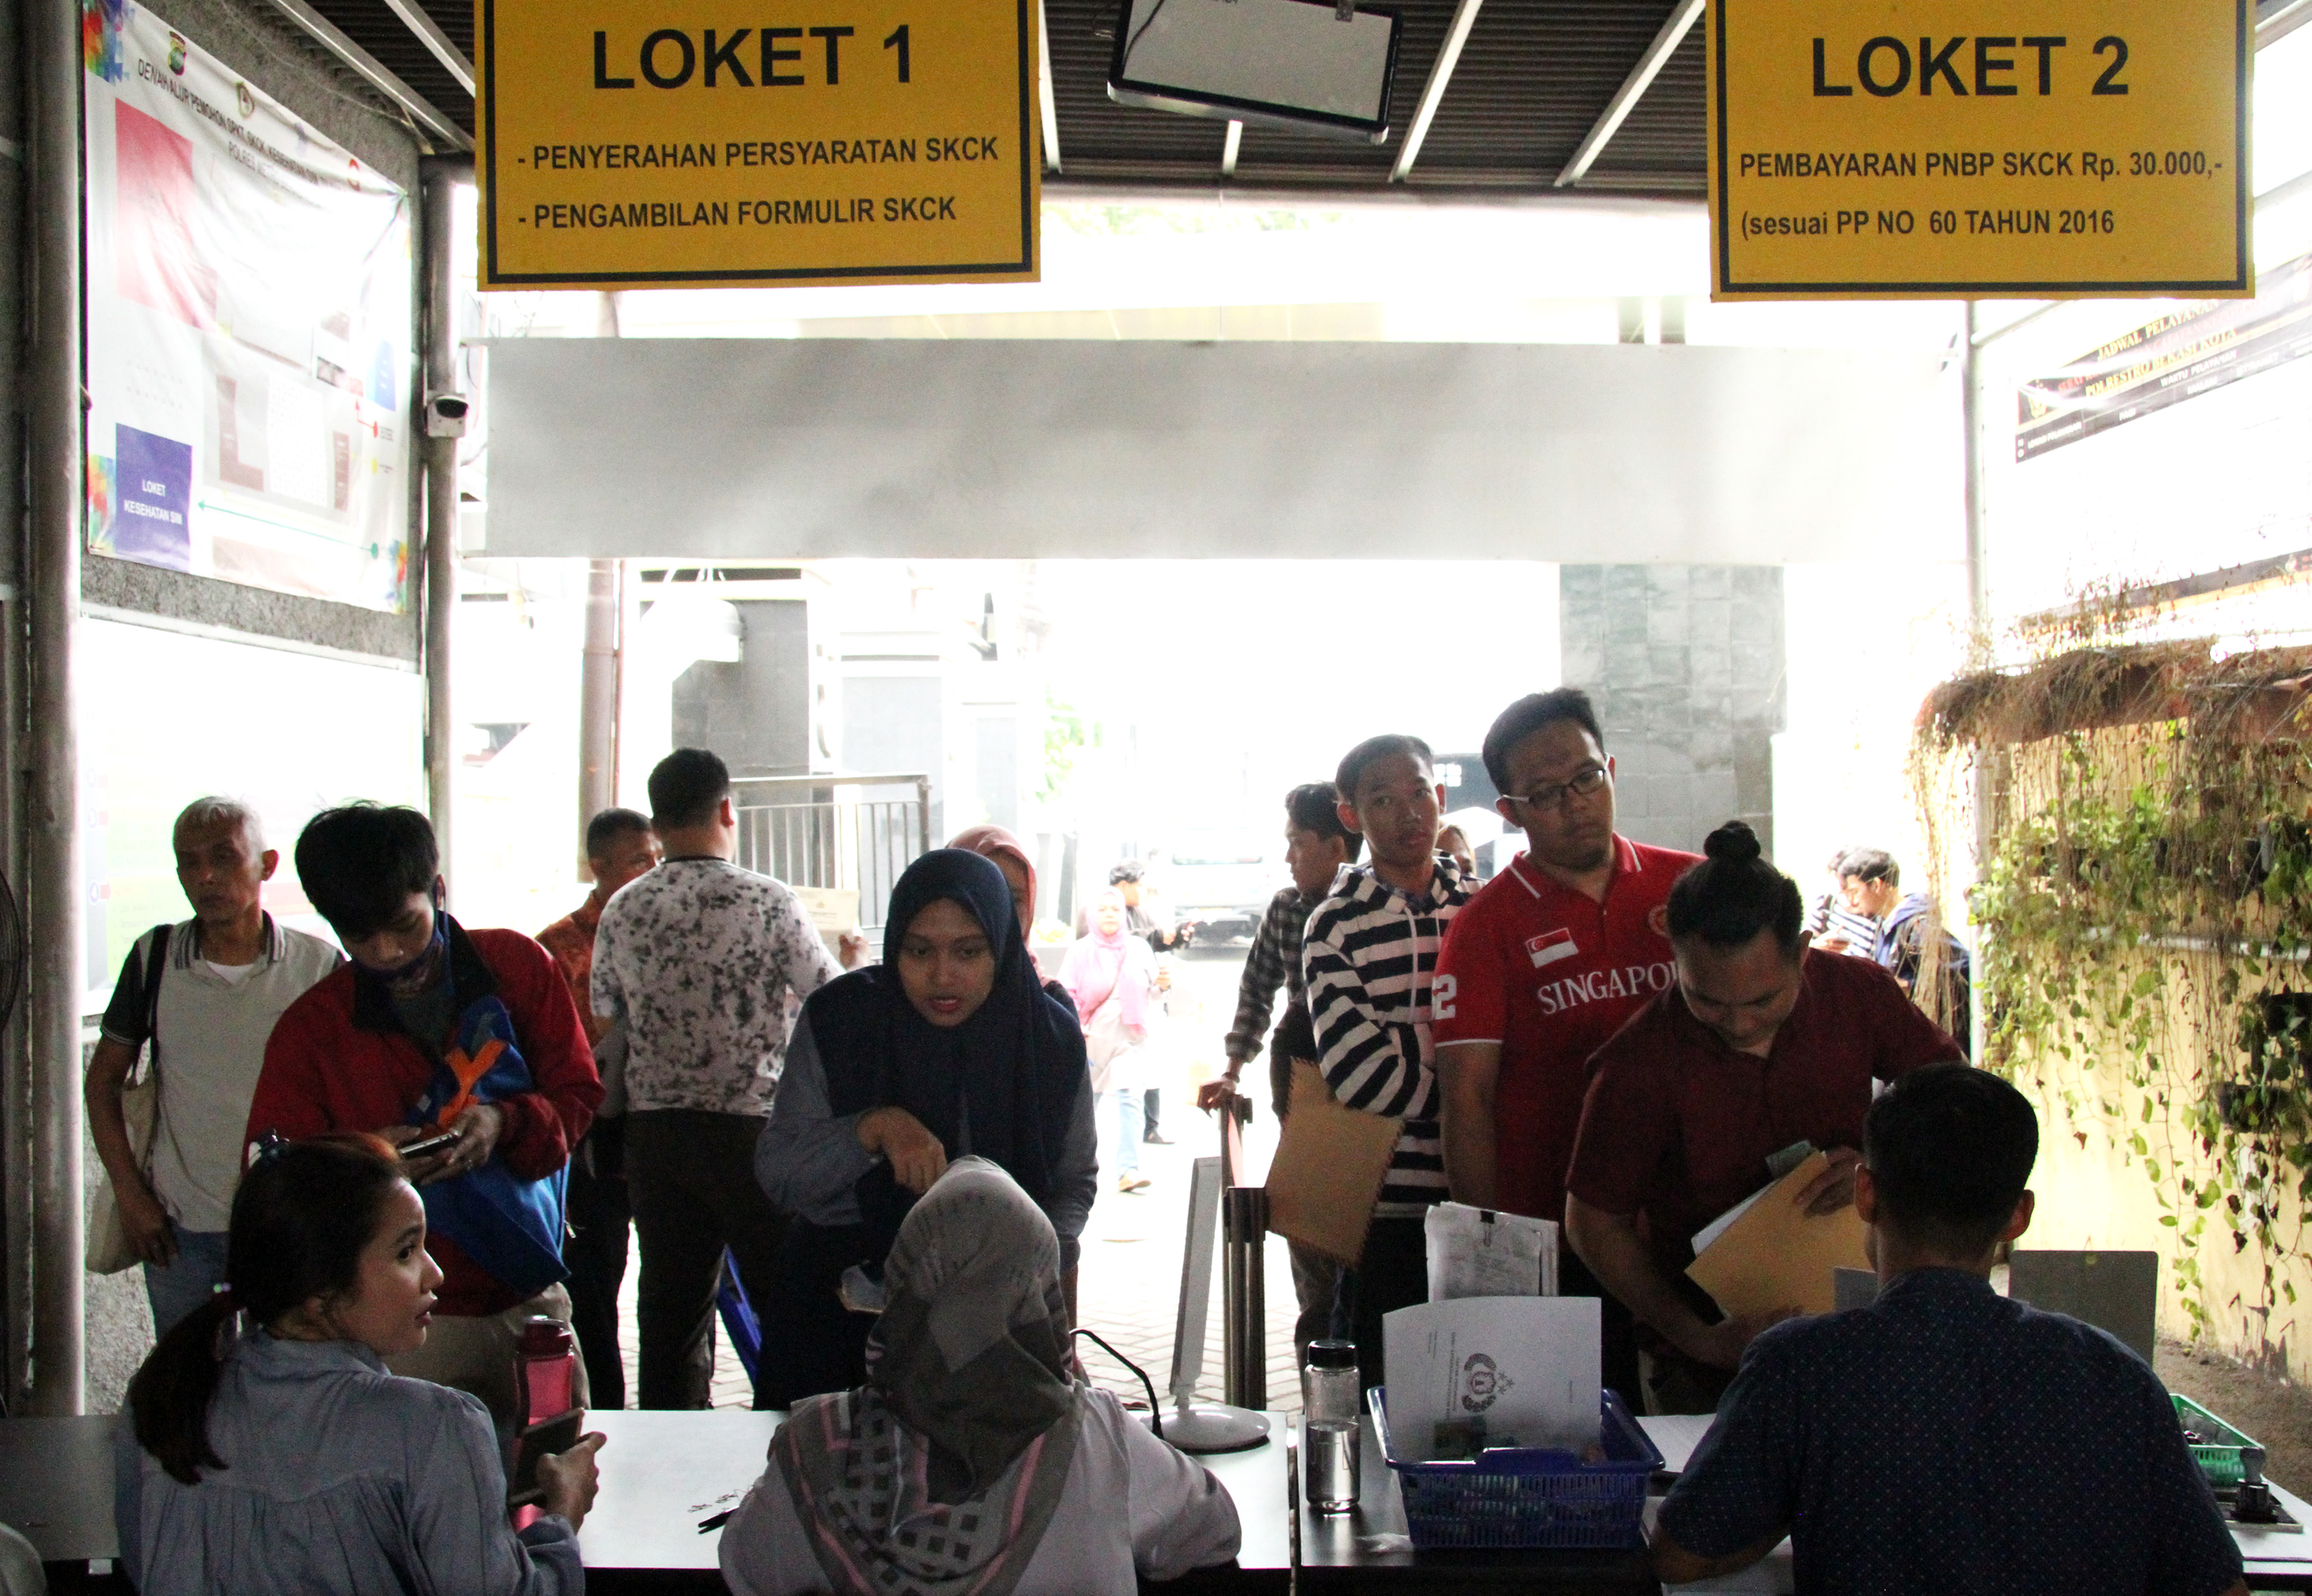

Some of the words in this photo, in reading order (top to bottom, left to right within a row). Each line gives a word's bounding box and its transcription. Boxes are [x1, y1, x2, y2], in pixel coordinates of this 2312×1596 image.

[594, 26, 855, 90] LOKET
[883, 24, 910, 83] 1
[1813, 36, 2067, 97] LOKET
[2092, 35, 2129, 95] 2
[138, 58, 169, 92] DENAH
[533, 143, 716, 169] PENYERAHAN
[725, 139, 916, 166] PERSYARATAN
[926, 136, 999, 162] SKCK
[1741, 153, 1916, 177] PEMBAYARAN
[1926, 152, 1995, 176] PNBP
[2003, 152, 2073, 176] SKCK
[2083, 152, 2120, 181] Rp.
[2130, 151, 2222, 179] 30.000,-
[535, 202, 728, 228] PENGAMBILAN
[738, 198, 875, 225] FORMULIR
[884, 196, 955, 222] SKCK
[1742, 210, 1828, 240] (sesuai
[1837, 210, 1869, 234] PP
[1878, 210, 1914, 234] NO
[1930, 210, 1957, 234] 60
[1965, 210, 2050, 234] TAHUN
[2059, 210, 2114, 233] 2016
[2098, 331, 2143, 361] JADWAL
[2145, 299, 2220, 338] PELAYANAN
[2085, 361, 2151, 397] POLRESTRO
[2152, 340, 2197, 370] BEKASI
[2199, 328, 2239, 350] KOTA
[142, 478, 166, 497] LOKET
[124, 499, 169, 522] KESEHATAN
